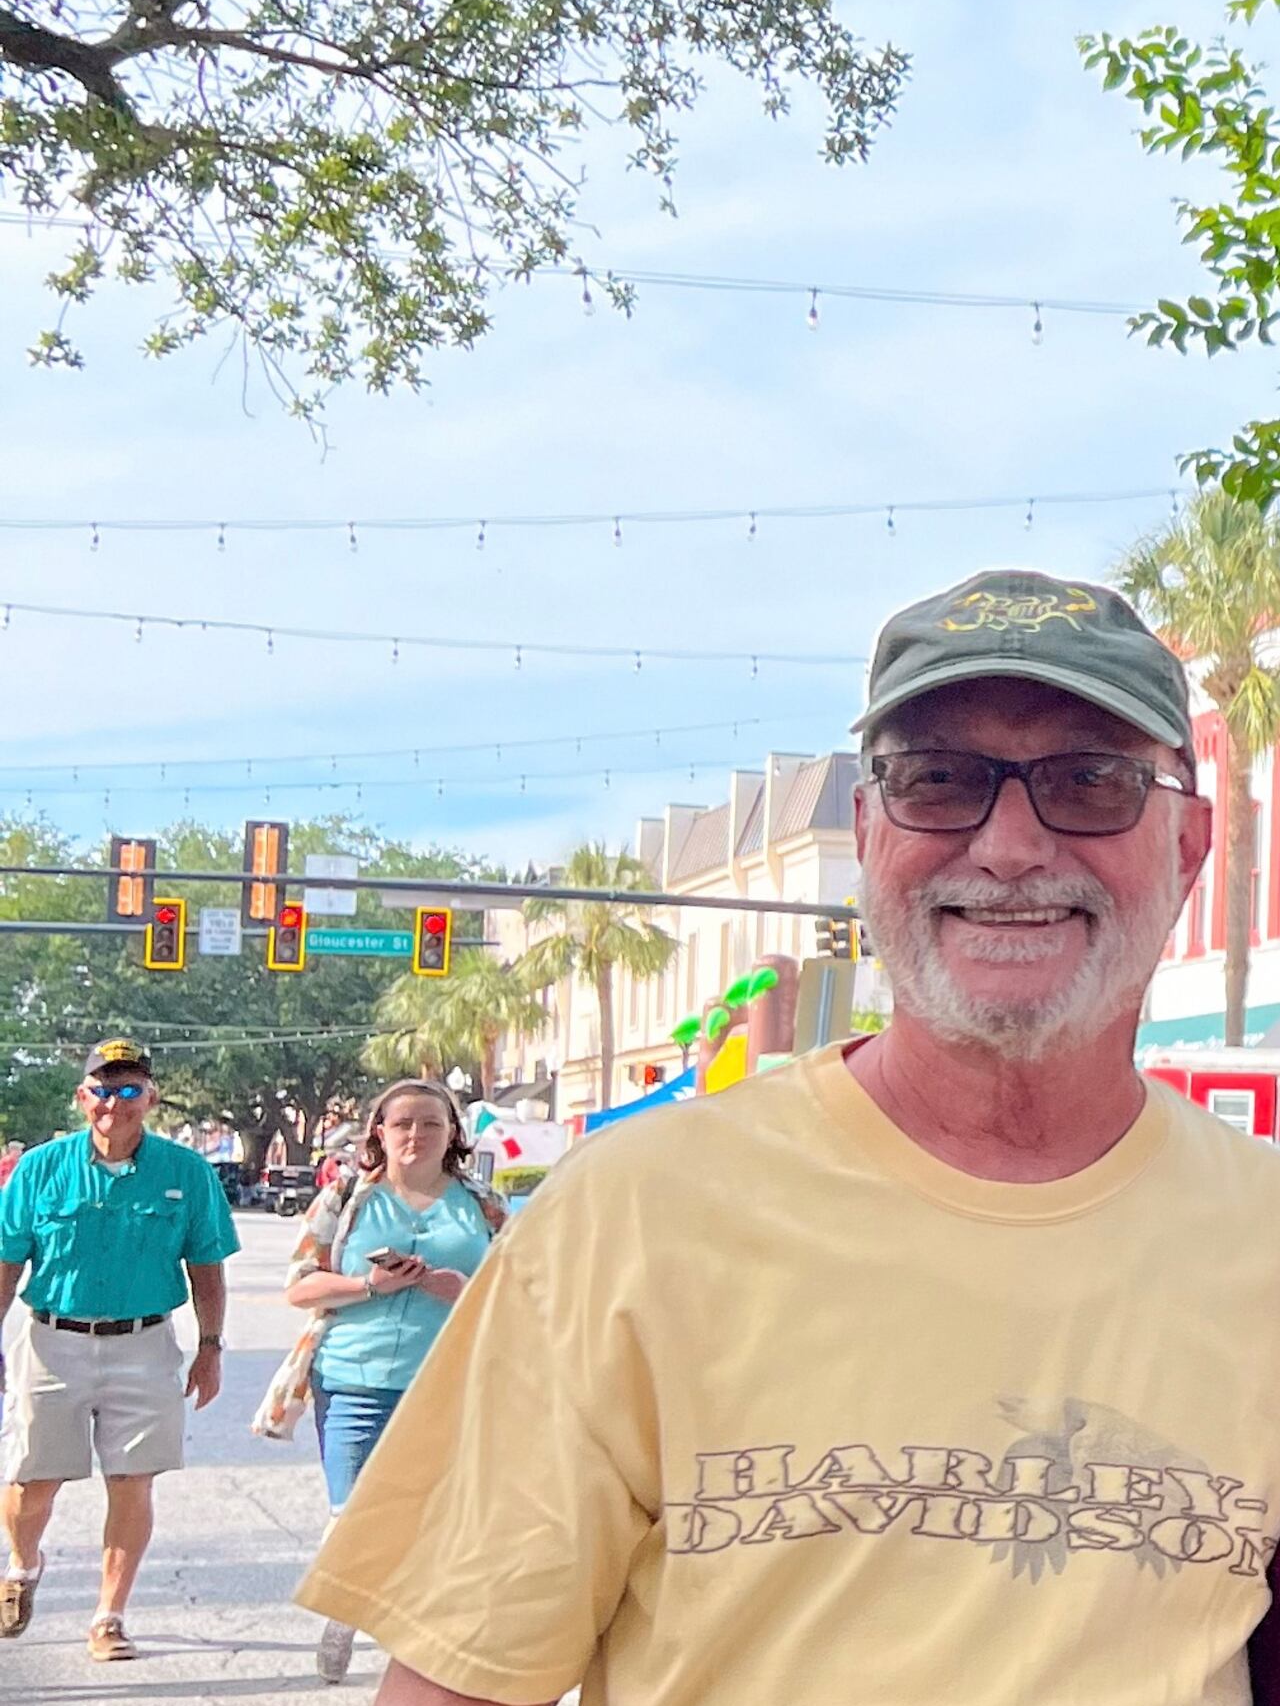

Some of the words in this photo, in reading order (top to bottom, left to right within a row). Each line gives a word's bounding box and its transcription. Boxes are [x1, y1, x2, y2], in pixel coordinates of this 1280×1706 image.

[309, 933, 385, 949] Gloucester
[392, 936, 409, 950] St
[695, 1444, 1268, 1524] HARLEY-
[666, 1493, 1278, 1577] DAVIDSON
